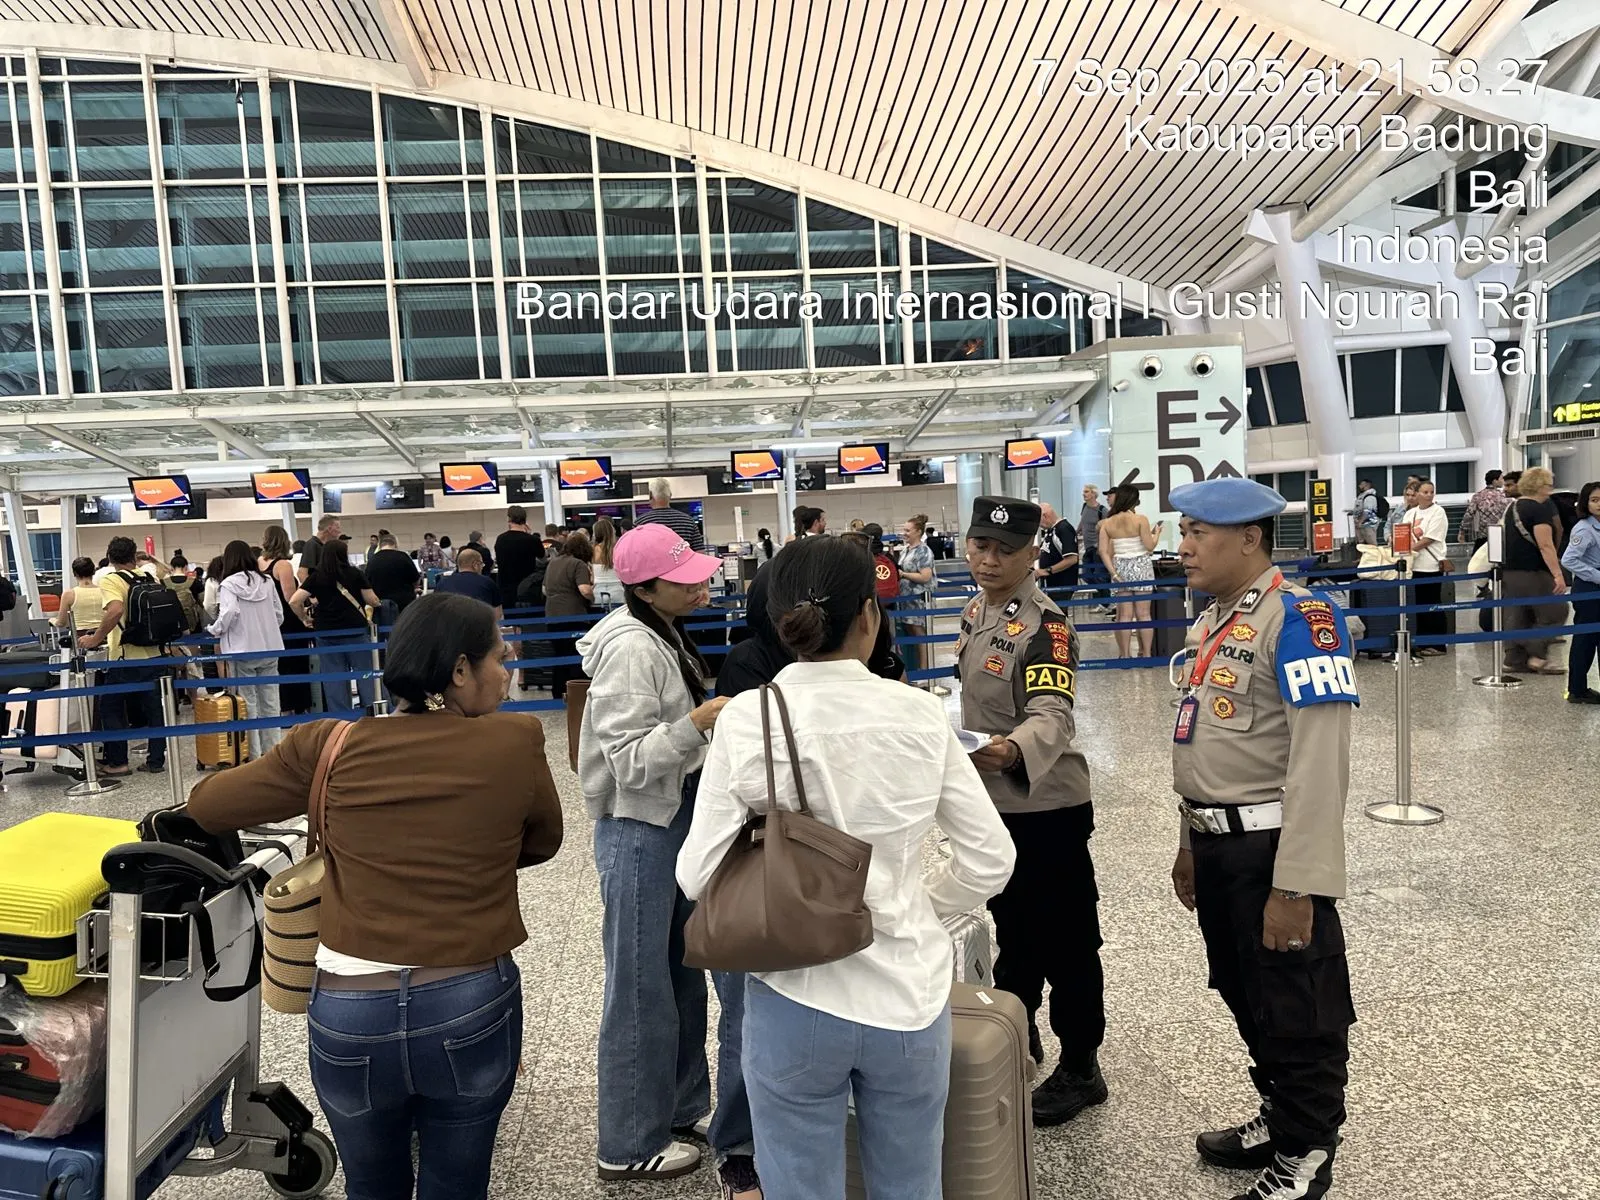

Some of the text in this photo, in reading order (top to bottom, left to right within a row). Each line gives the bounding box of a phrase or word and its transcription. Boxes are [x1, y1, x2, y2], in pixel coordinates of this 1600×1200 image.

[1157, 389, 1201, 450] E
[1158, 454, 1205, 513] D
[1317, 505, 1323, 514] E
[989, 636, 1016, 654] POLRI
[1217, 644, 1255, 664] POLRI
